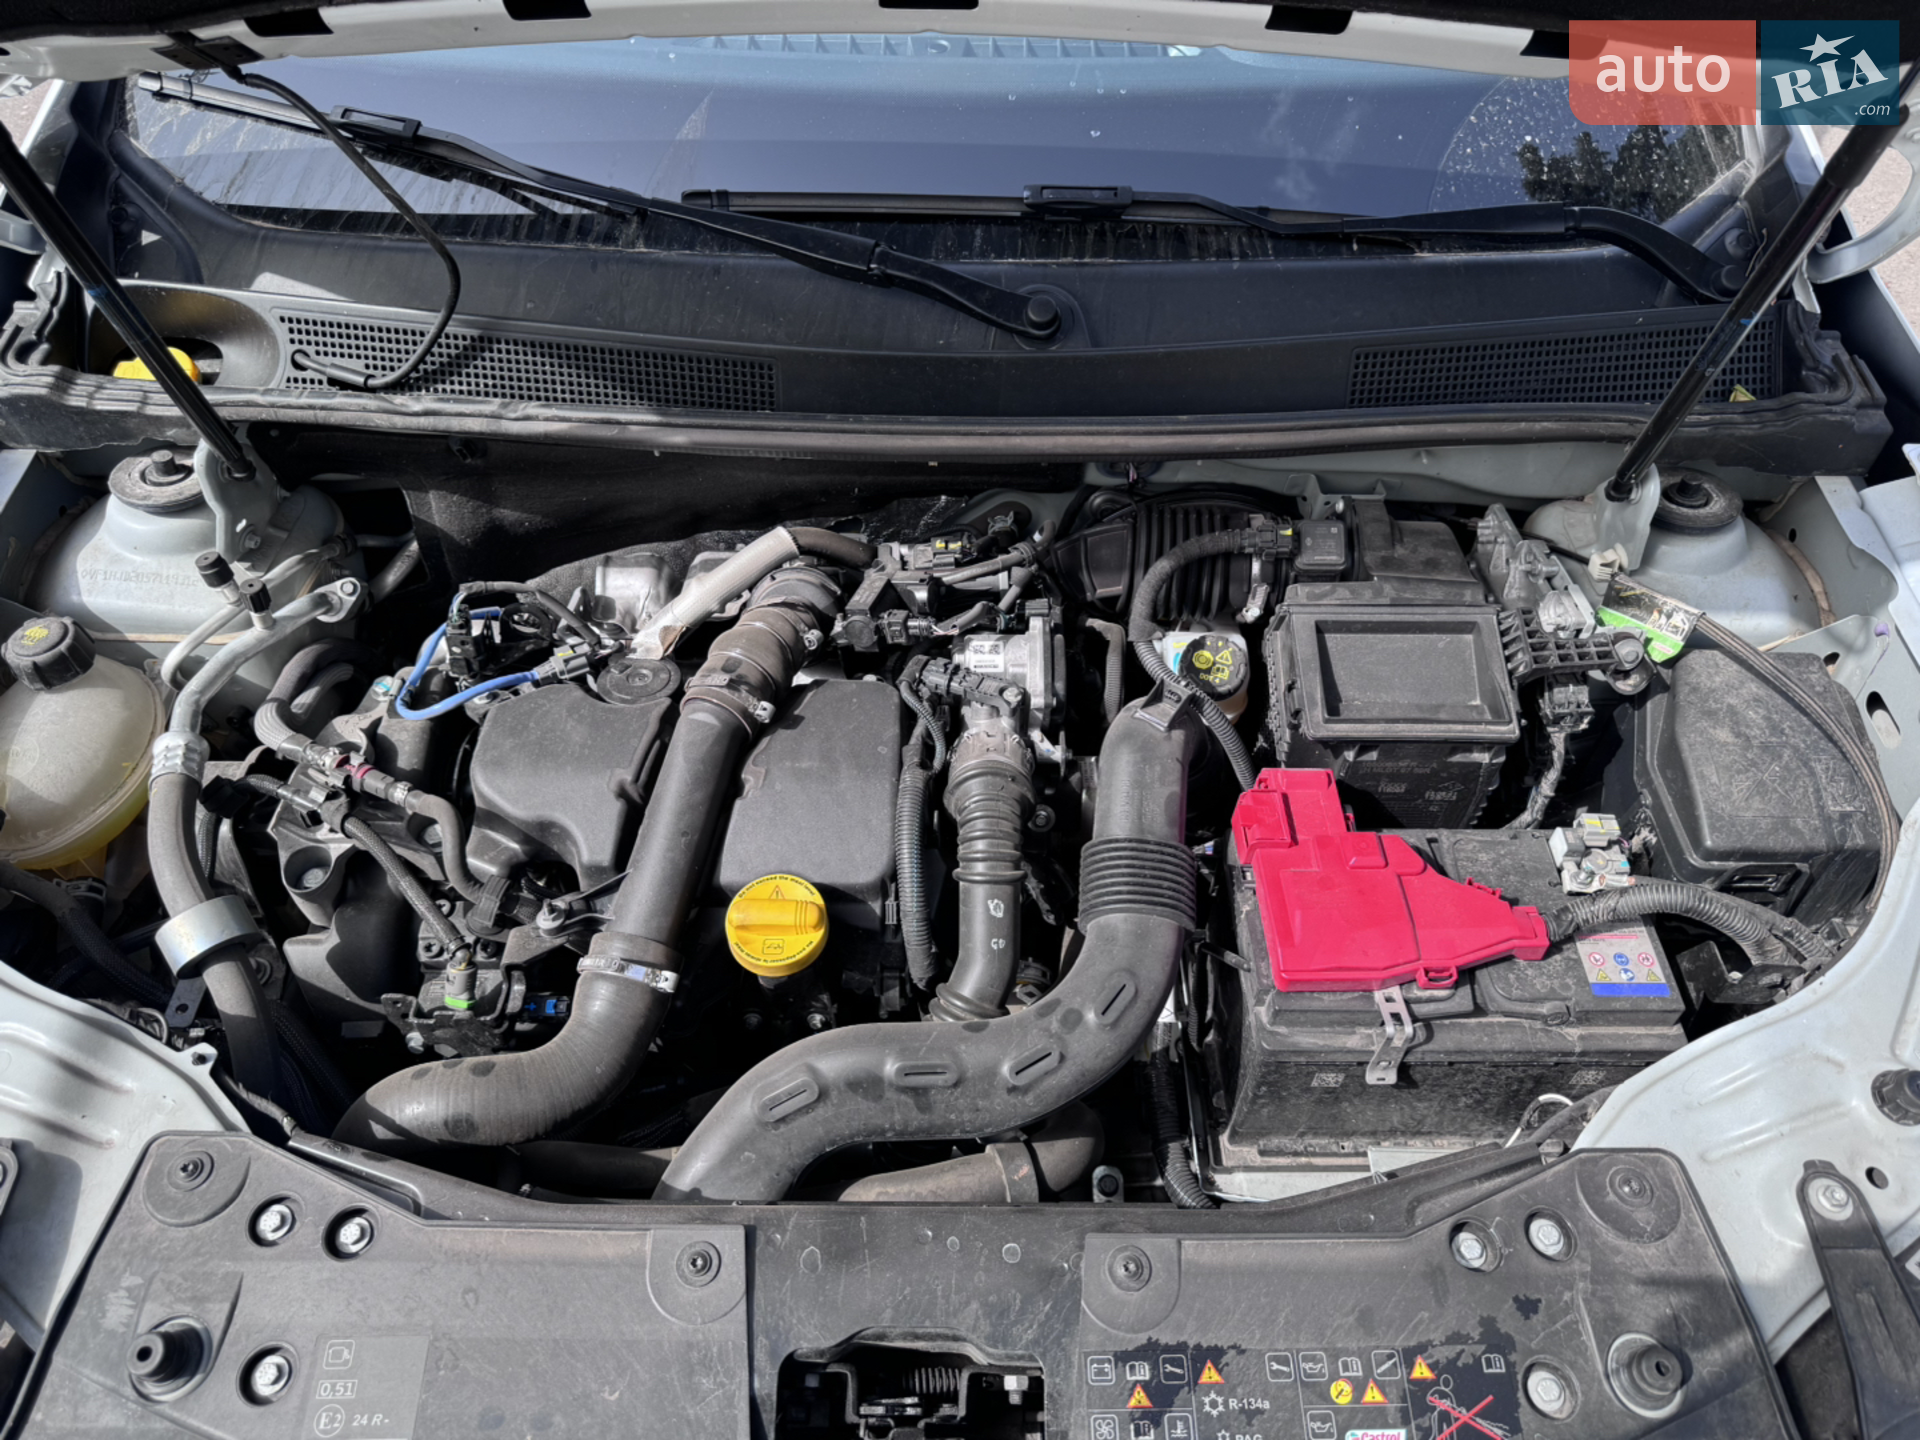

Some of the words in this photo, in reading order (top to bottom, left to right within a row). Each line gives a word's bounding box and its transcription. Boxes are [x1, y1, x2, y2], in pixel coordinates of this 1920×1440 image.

[320, 1382, 353, 1398] 0,51
[1228, 1398, 1270, 1410] R-134a
[318, 1411, 342, 1430] E2
[352, 1414, 368, 1426] 24
